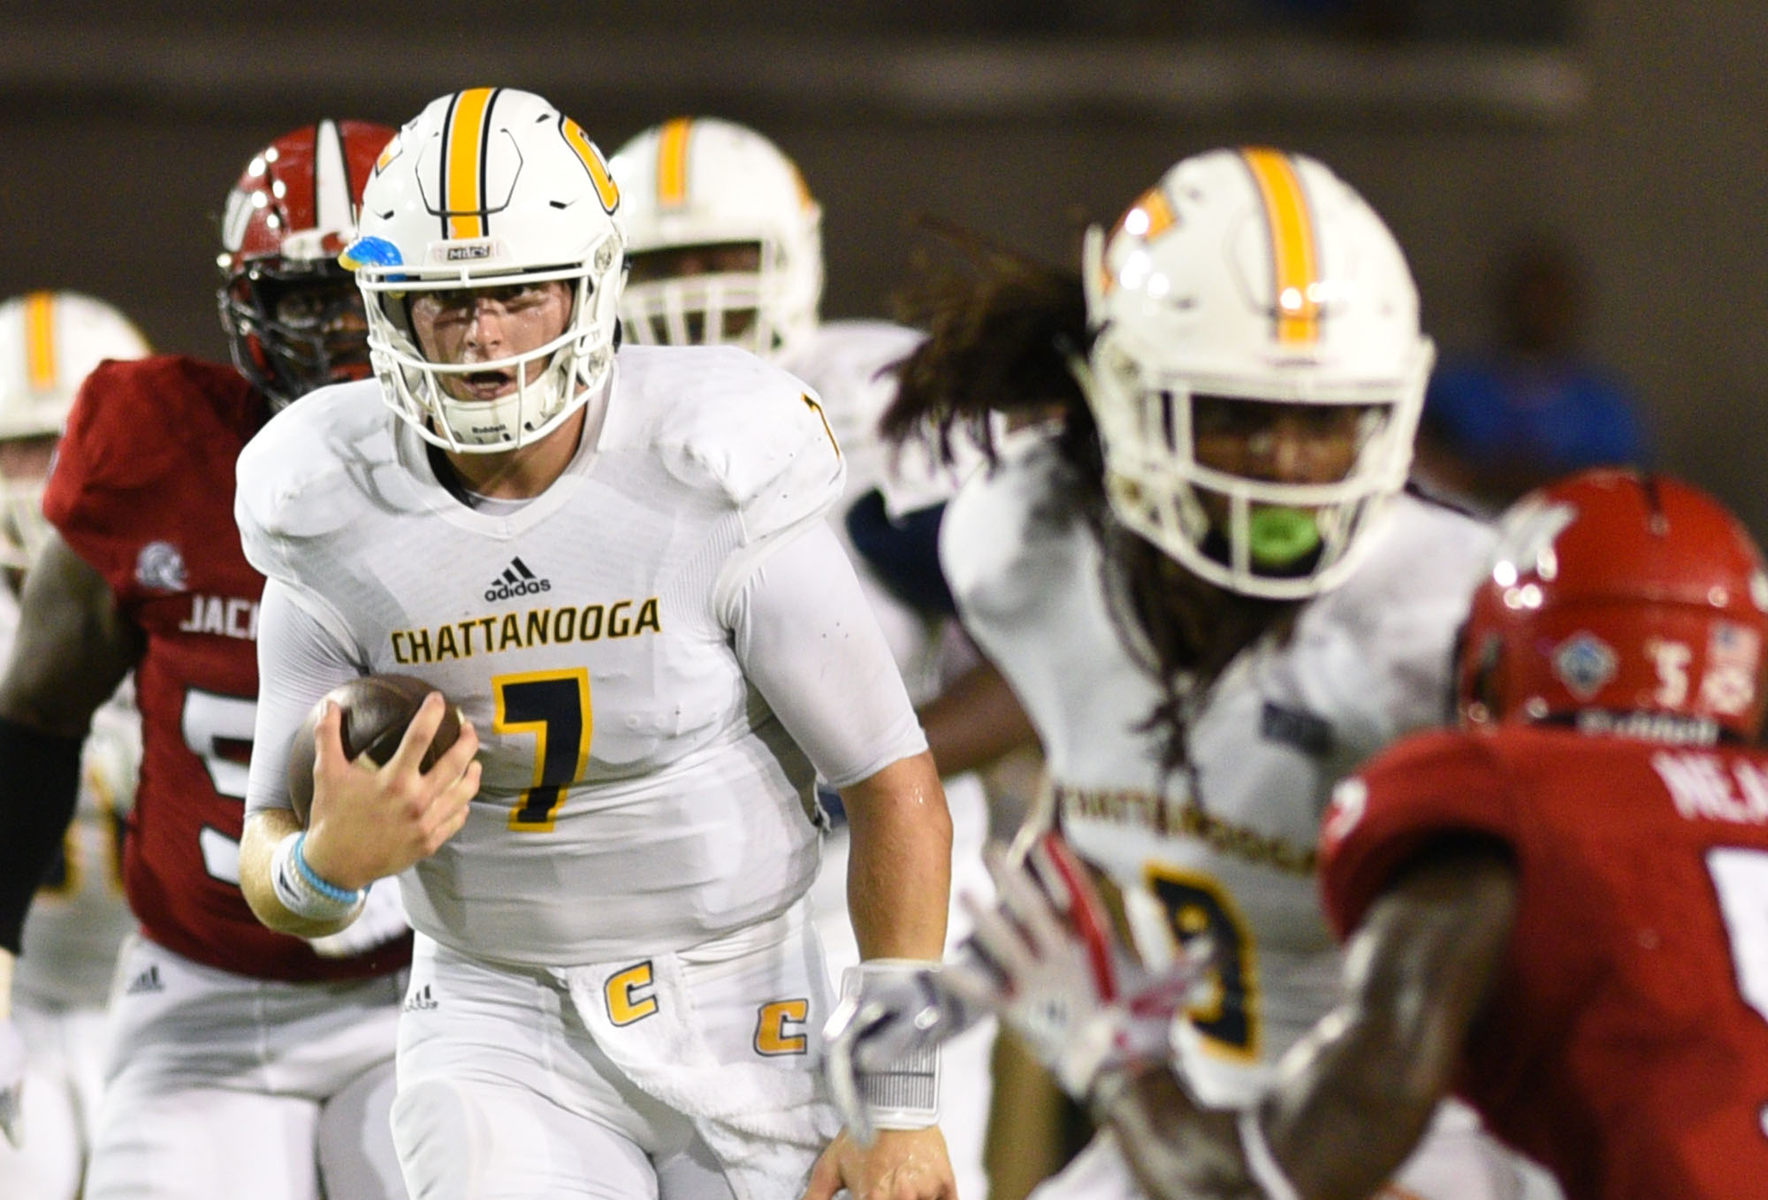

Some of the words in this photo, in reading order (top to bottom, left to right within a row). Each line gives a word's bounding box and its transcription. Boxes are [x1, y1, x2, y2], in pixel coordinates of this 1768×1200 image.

[484, 577, 551, 601] adidas
[391, 597, 663, 665] CHATTANOOGA
[491, 666, 593, 832] 7
[604, 959, 660, 1028] C
[753, 998, 809, 1058] C
